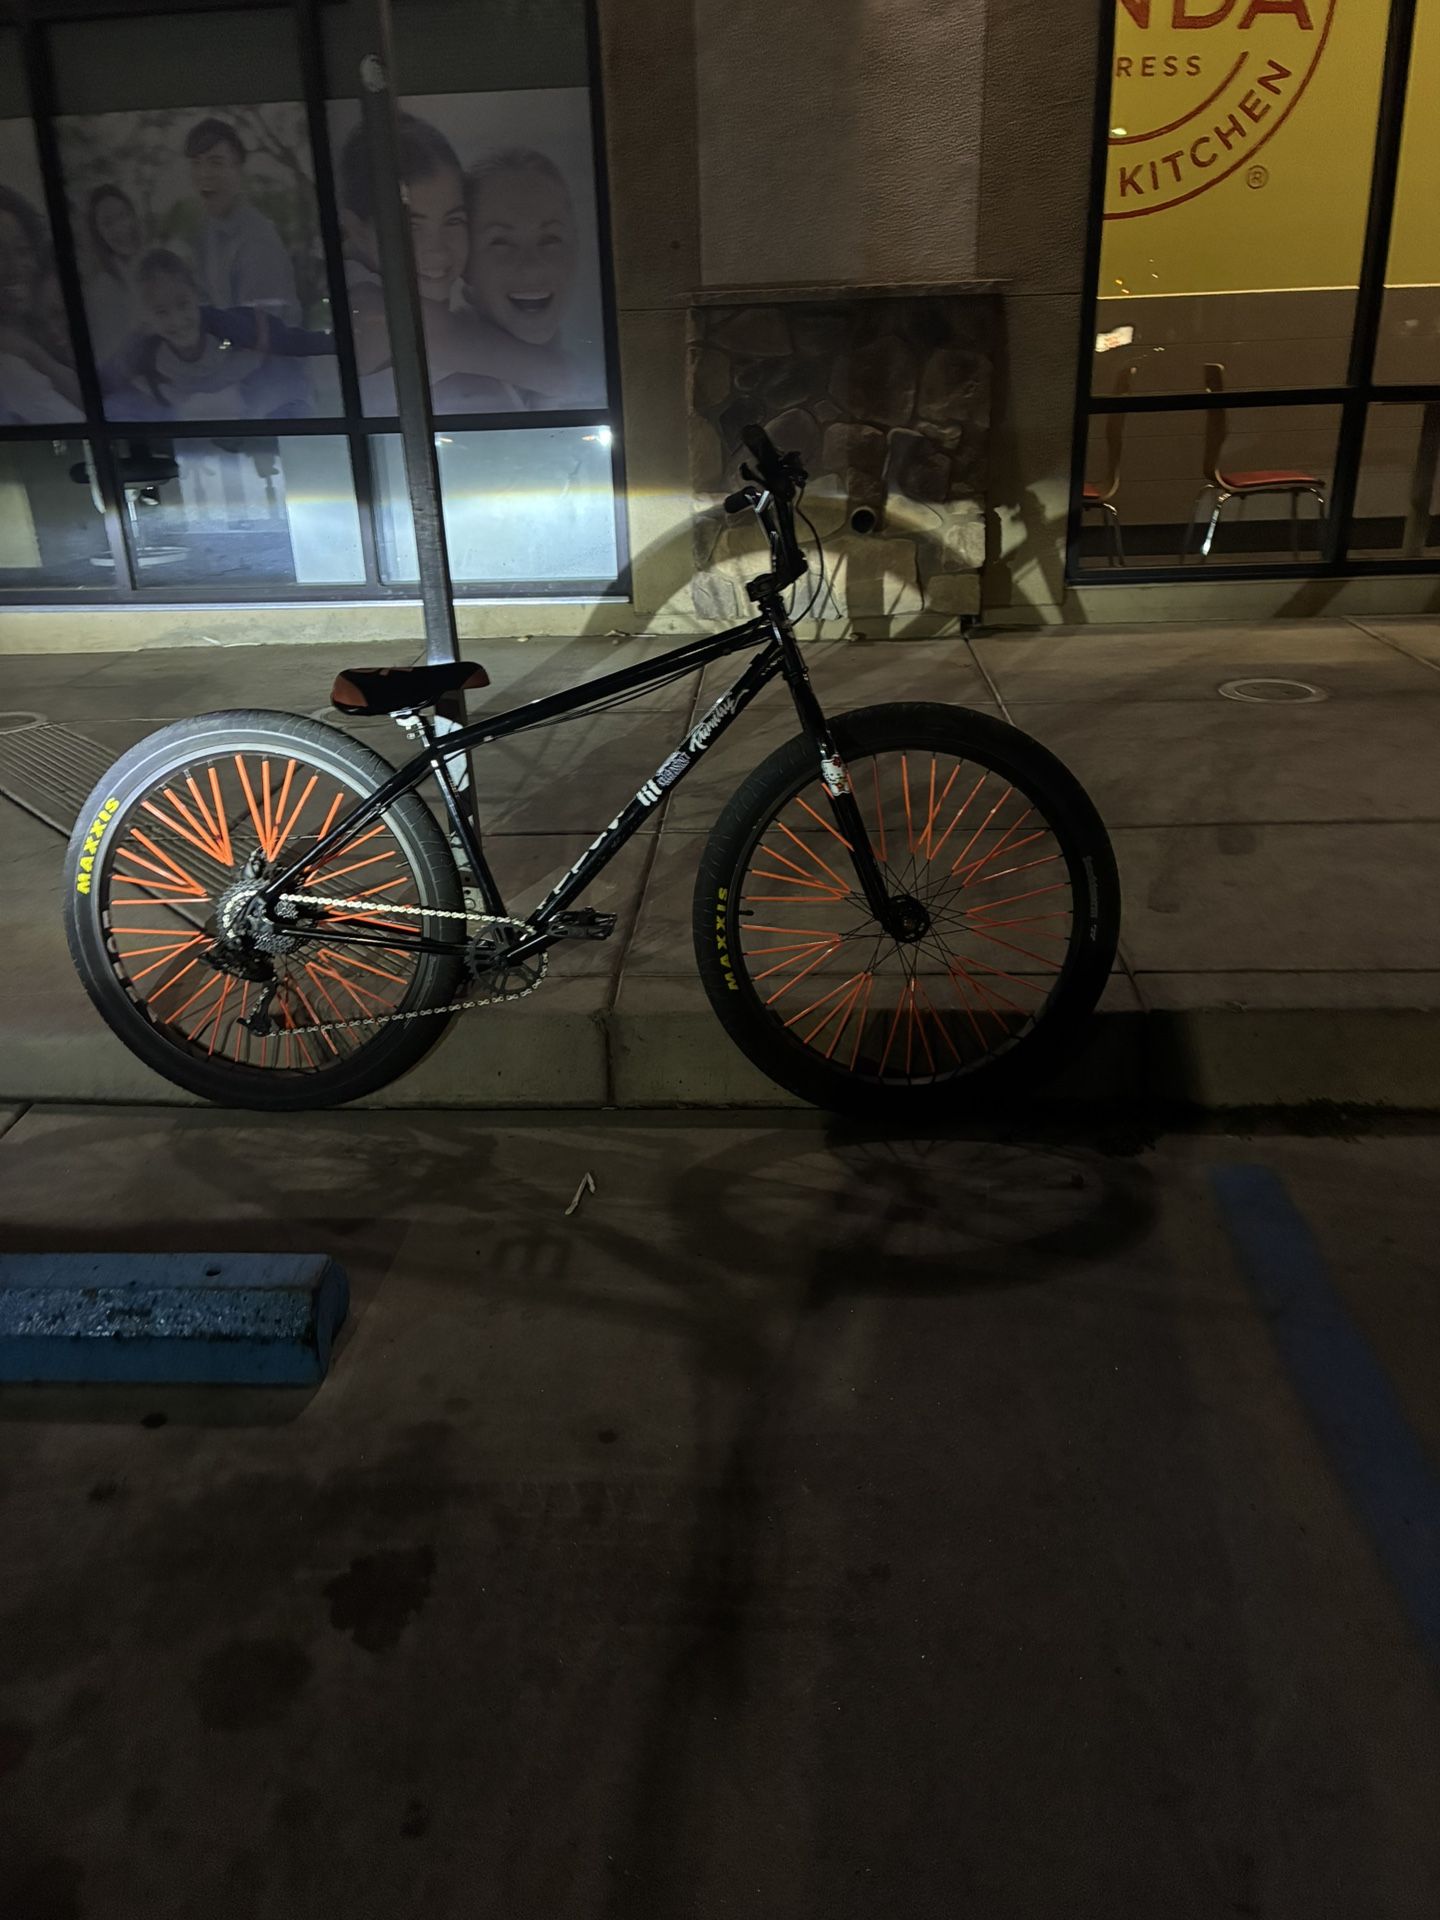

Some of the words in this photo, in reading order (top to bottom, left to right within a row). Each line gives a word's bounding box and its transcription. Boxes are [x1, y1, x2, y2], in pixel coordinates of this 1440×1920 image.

[1116, 56, 1201, 77] RESS
[1119, 59, 1292, 197] KITCHEN
[76, 797, 120, 894] MAXXIS
[716, 887, 739, 990] MAXXIS
